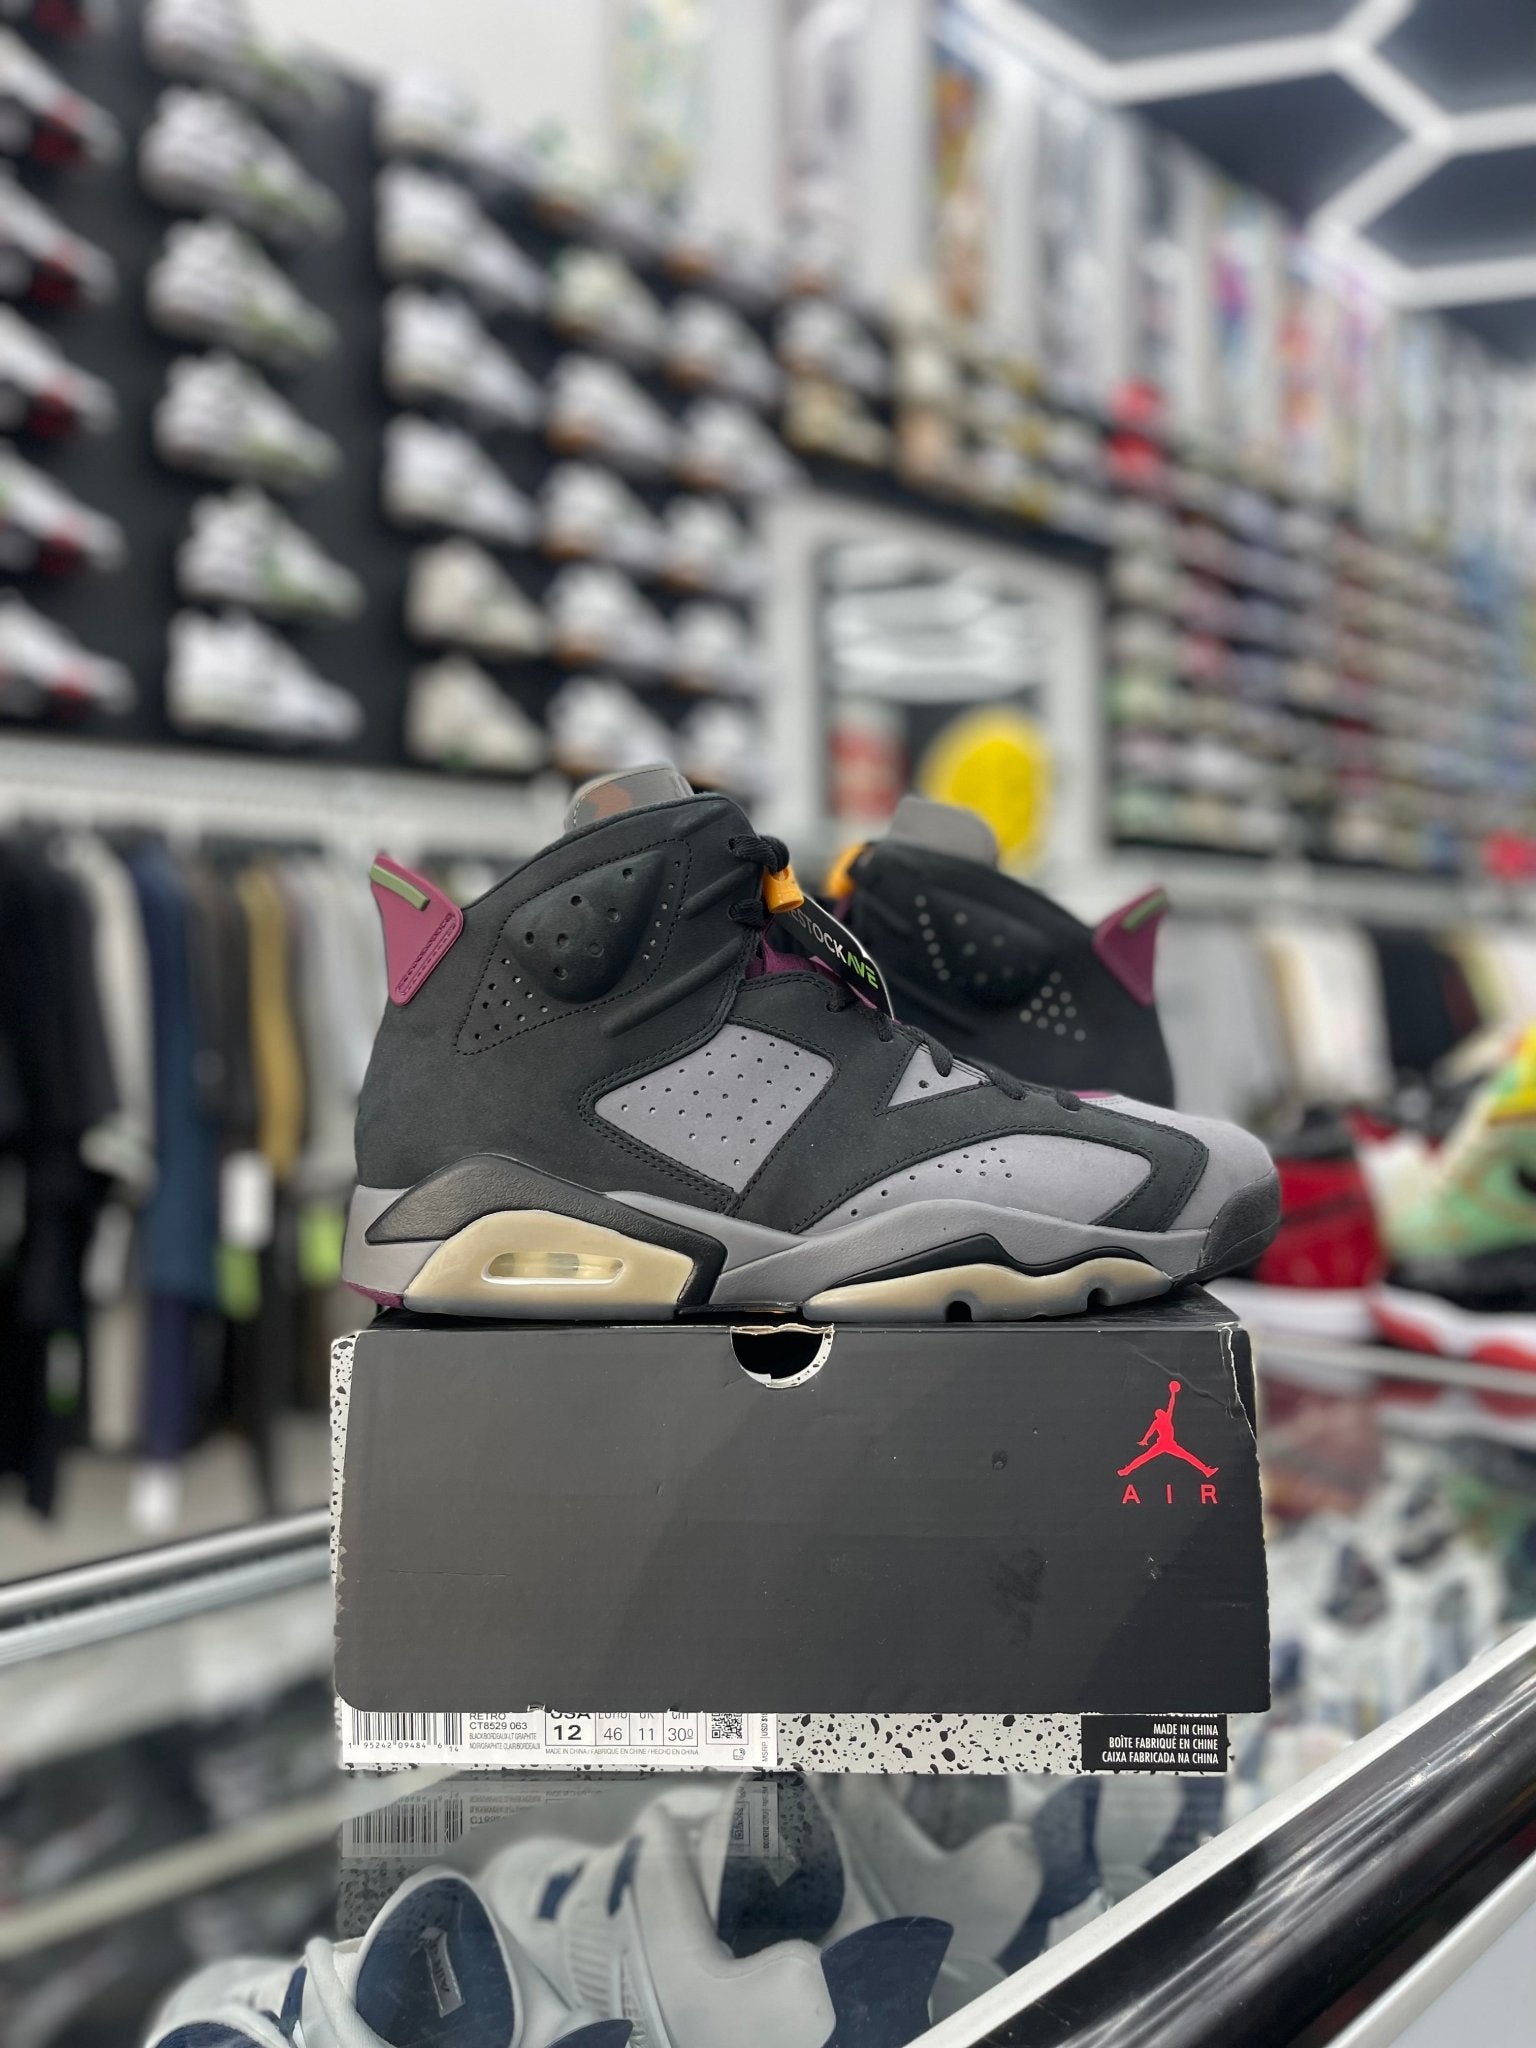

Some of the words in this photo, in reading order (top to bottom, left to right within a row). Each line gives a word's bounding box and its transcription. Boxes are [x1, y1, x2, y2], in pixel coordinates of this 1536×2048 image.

[1122, 1484, 1218, 1504] AIR
[469, 1722, 507, 1730] CT8529
[509, 1722, 528, 1730] 063
[553, 1724, 582, 1741] 12
[1153, 1723, 1178, 1735] MADE
[1180, 1724, 1189, 1735] IN
[1192, 1724, 1219, 1736] CHINA
[603, 1727, 623, 1741] 46
[638, 1728, 654, 1741] 11
[1109, 1734, 1133, 1748] BOÎTE
[1135, 1735, 1177, 1749] FABRIQUÉ
[1179, 1738, 1190, 1749] EN
[1192, 1738, 1218, 1750] CHINE
[1102, 1751, 1127, 1763] CAIXA
[1129, 1751, 1177, 1763] FABRICADA
[1178, 1752, 1190, 1764] NA
[1192, 1752, 1219, 1764] CHINA
